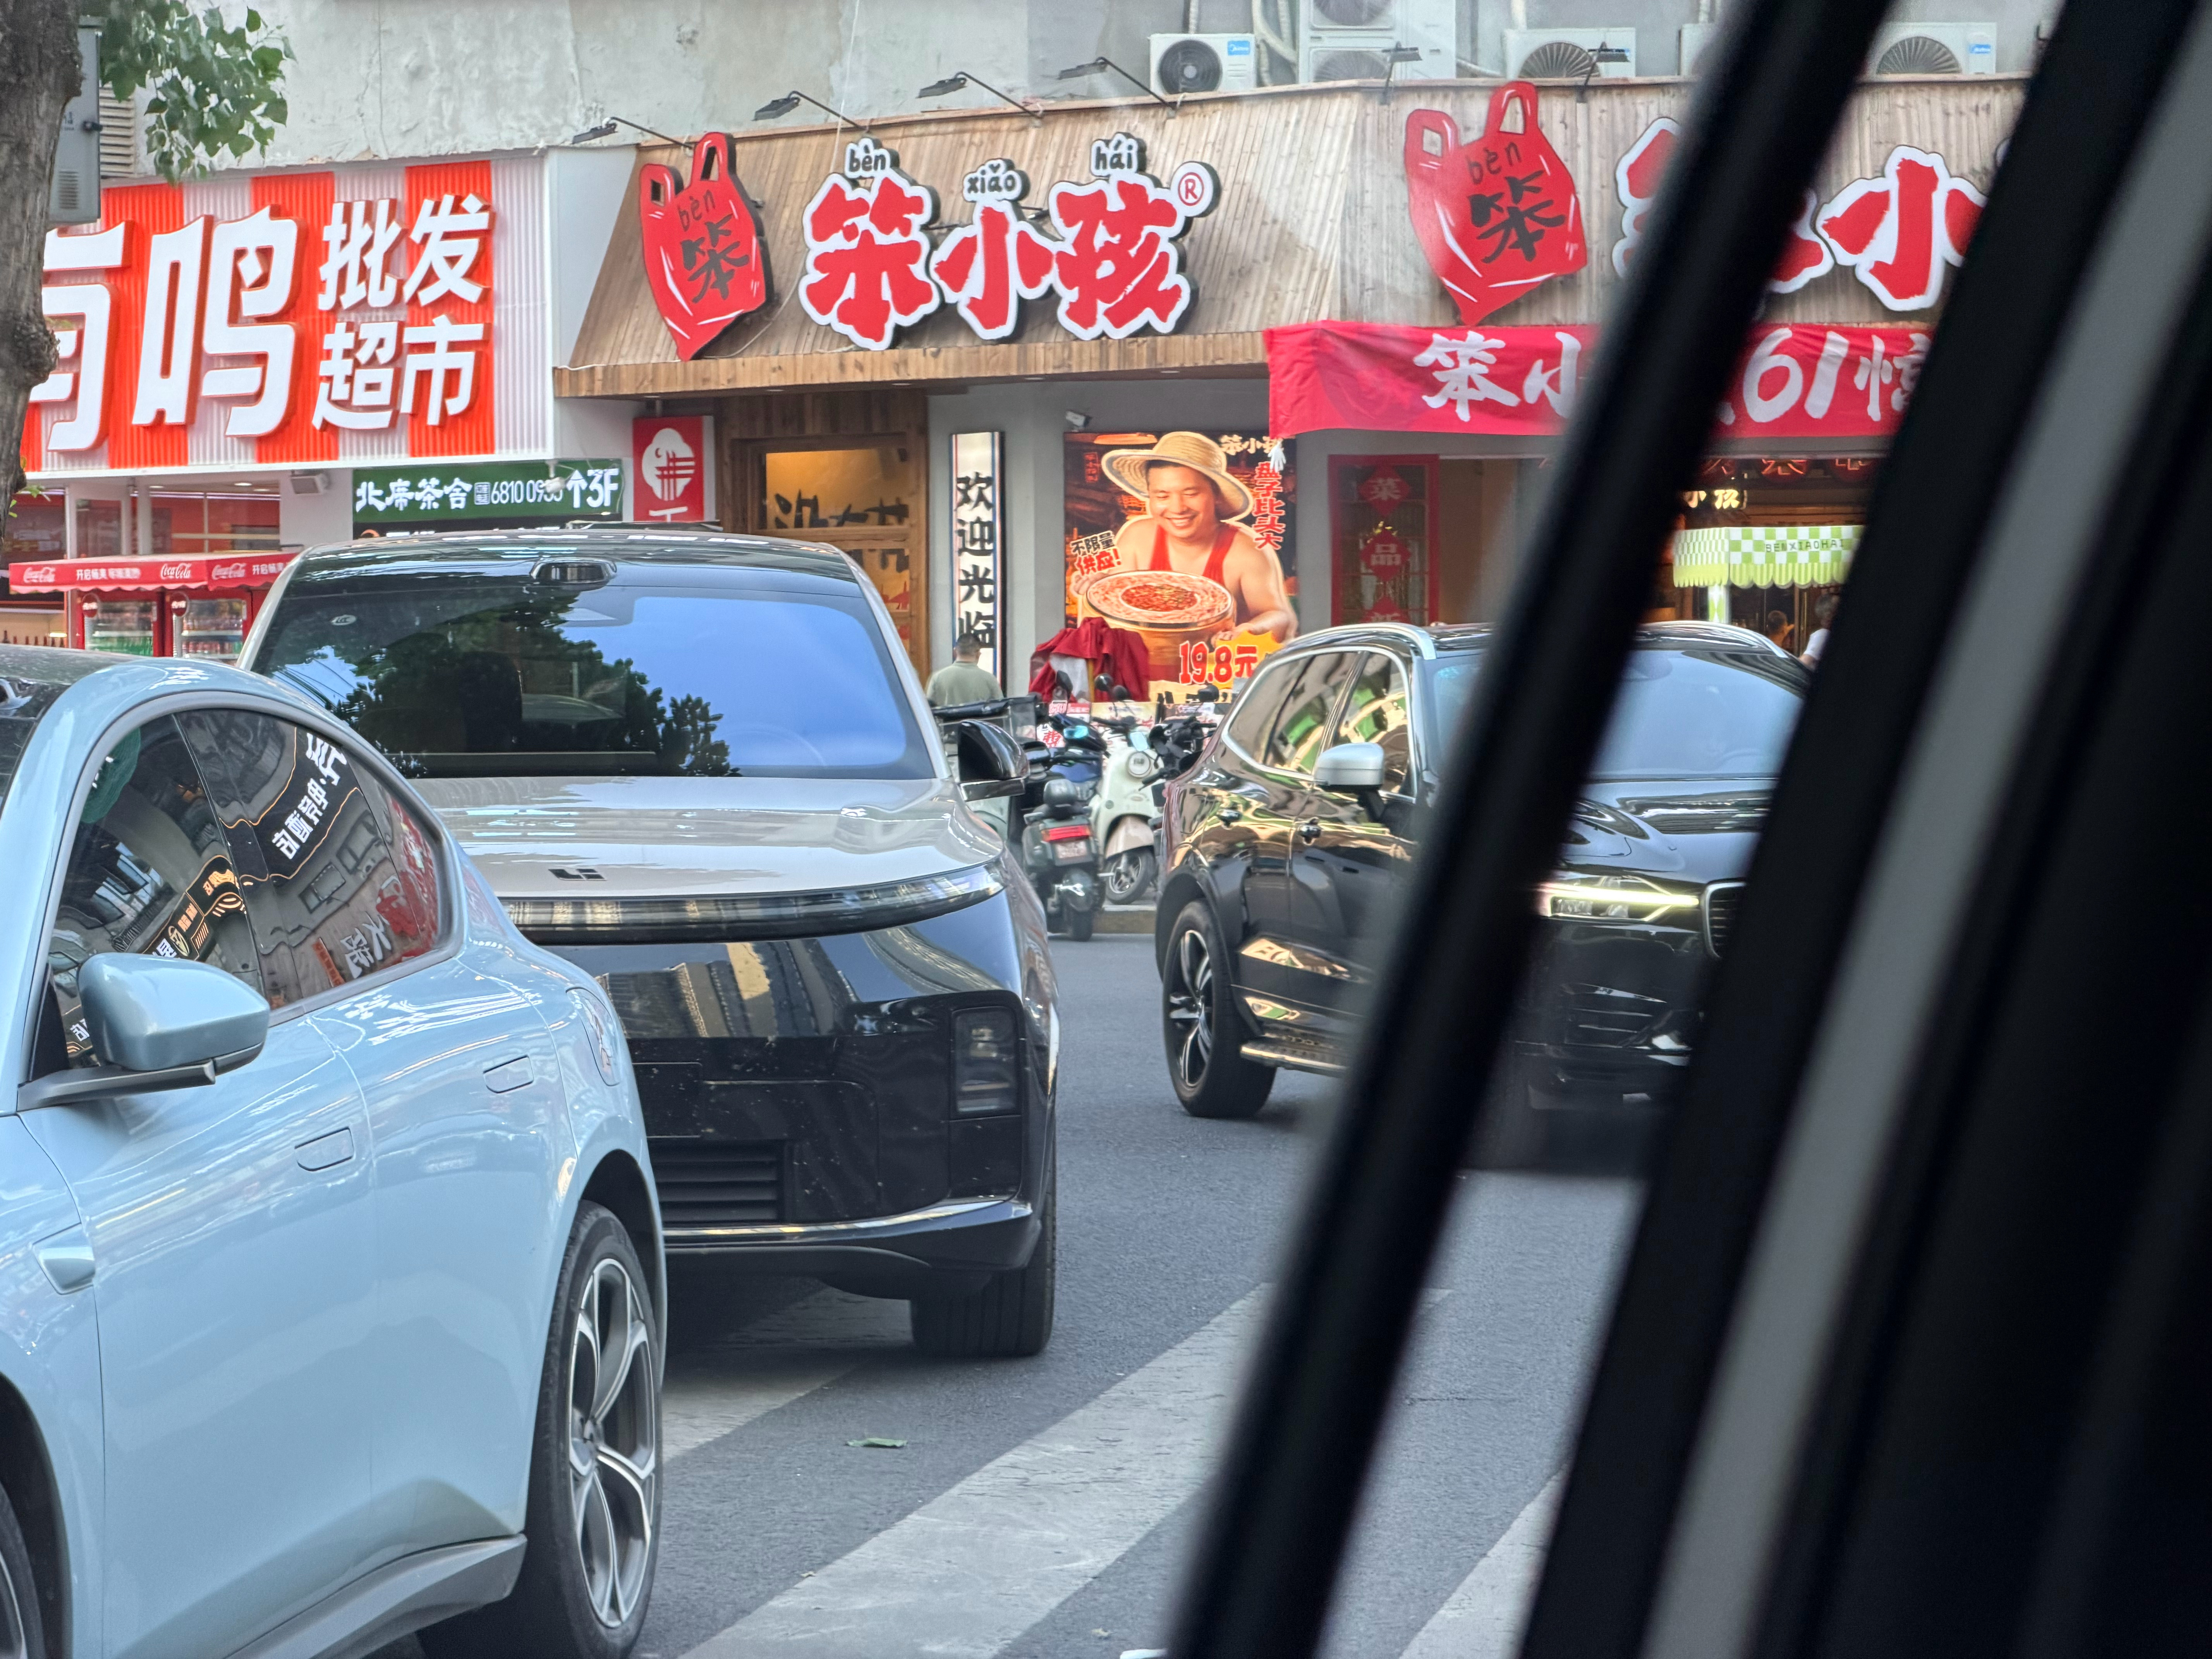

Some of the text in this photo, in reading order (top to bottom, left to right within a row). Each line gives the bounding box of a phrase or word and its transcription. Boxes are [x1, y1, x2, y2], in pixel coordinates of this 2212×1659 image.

[848, 138, 1134, 194] bèn xiǎo hái
[319, 194, 489, 310] 批发
[681, 213, 749, 303] 笨
[807, 178, 1181, 342] 笨小孩
[1468, 170, 1566, 264] 笨
[313, 315, 485, 429] 超市
[491, 481, 524, 504] 6810
[586, 468, 619, 508] 3F
[955, 471, 995, 648] 欢迎光临
[1071, 532, 1115, 555] 不限量
[1765, 539, 1844, 553] BENXIAOHAI
[1180, 642, 1257, 684] 19.8元
